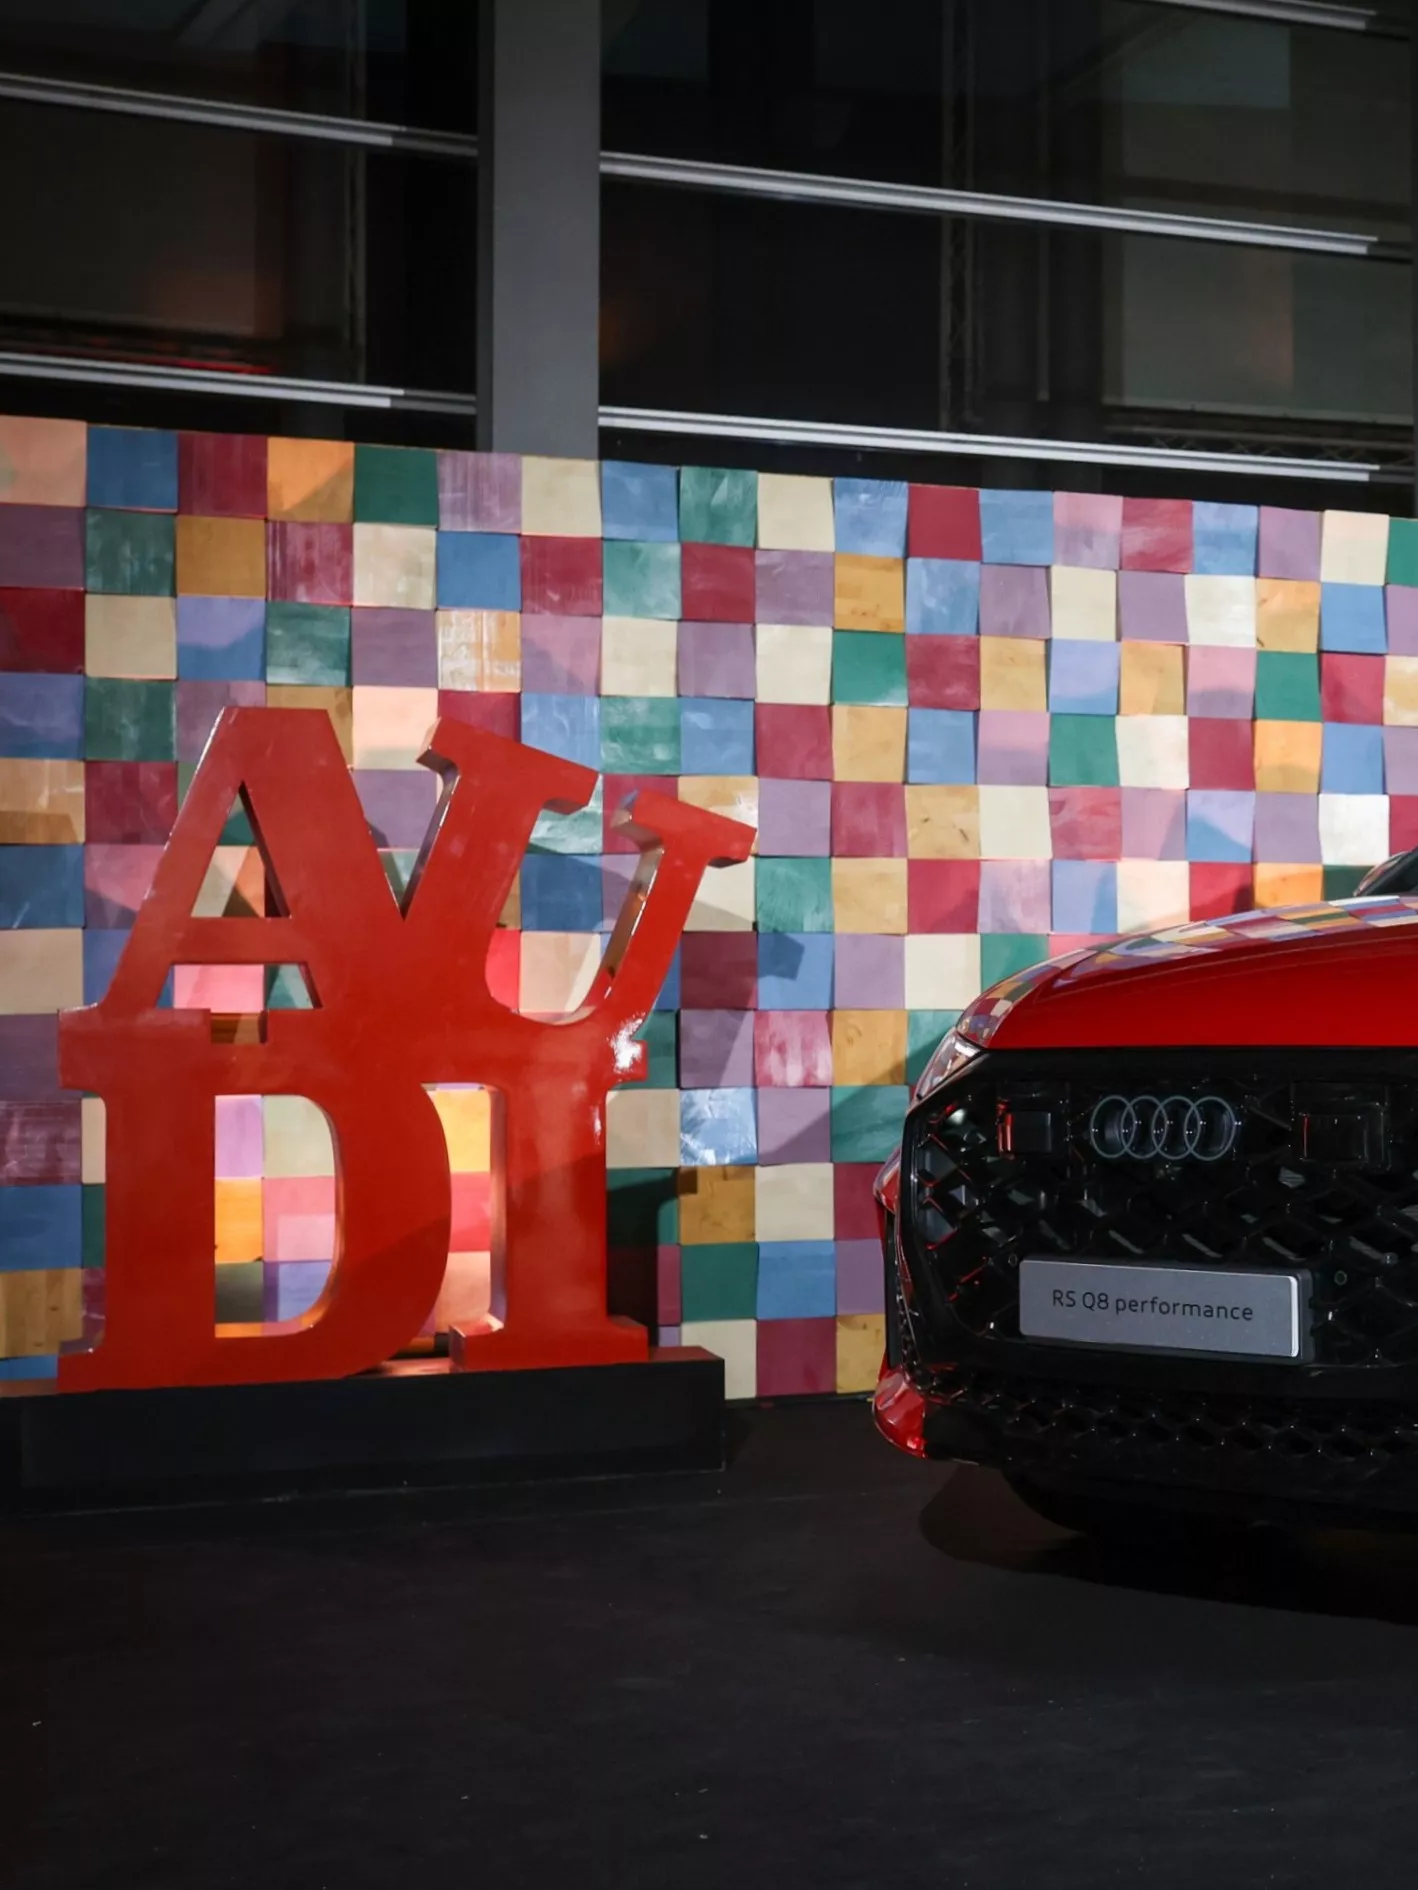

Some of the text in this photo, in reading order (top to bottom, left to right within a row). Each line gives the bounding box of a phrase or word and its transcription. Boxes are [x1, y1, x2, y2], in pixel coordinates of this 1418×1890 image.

[1052, 1289, 1254, 1321] RS Q8 performance
